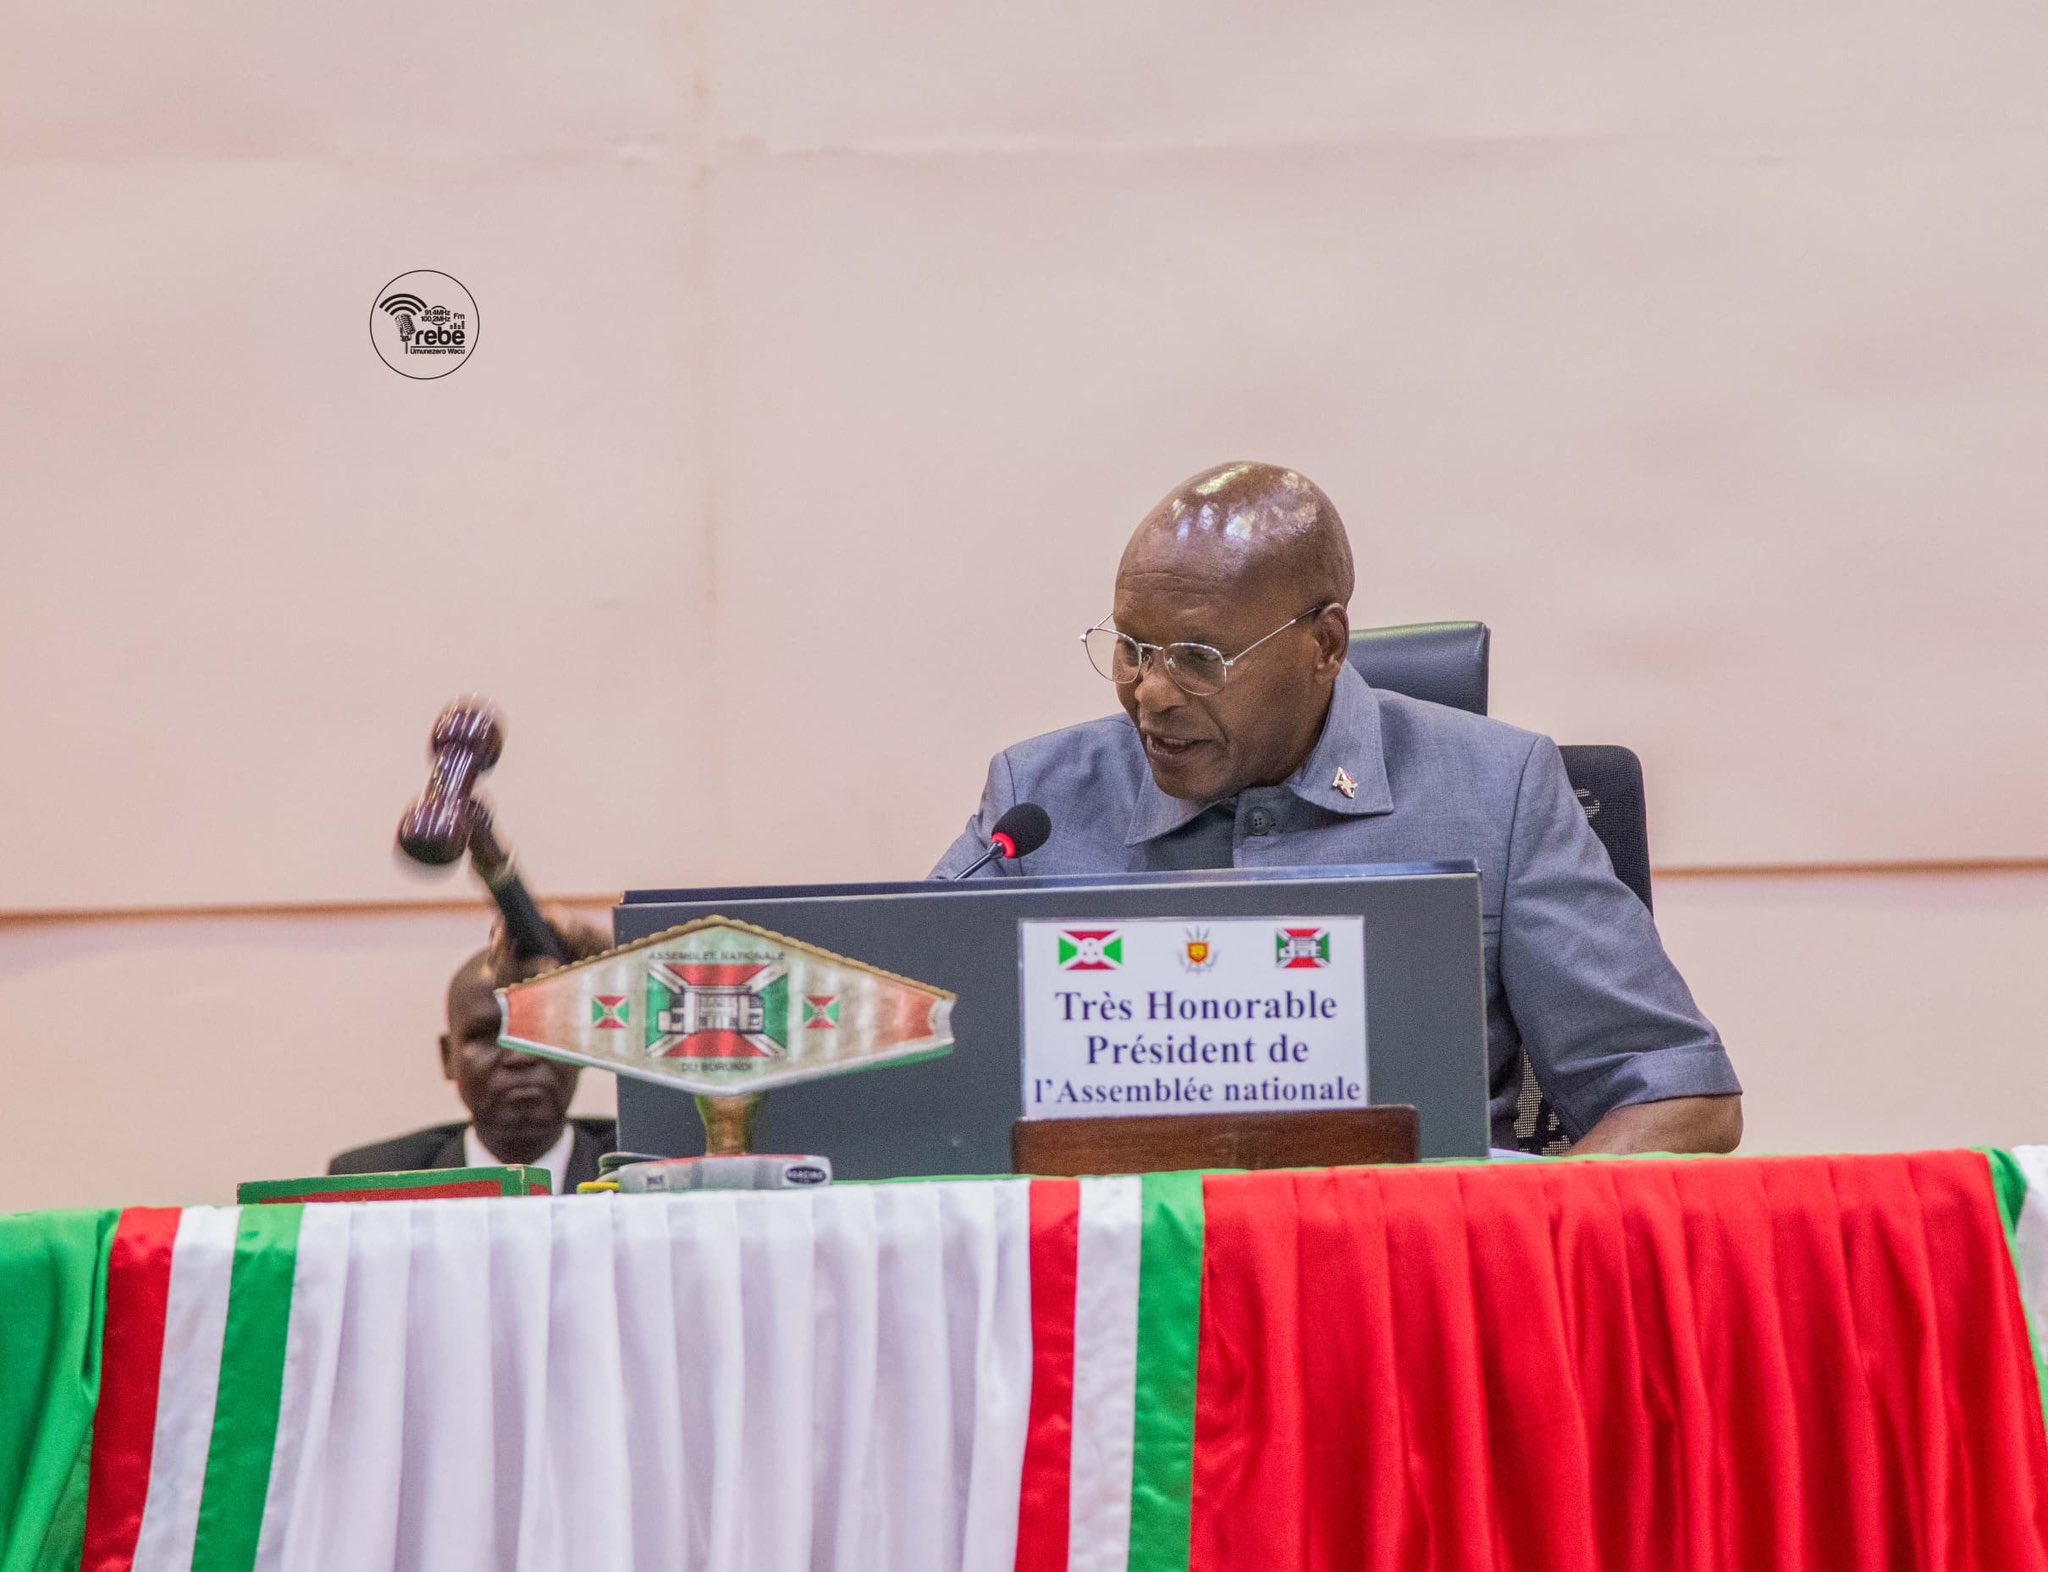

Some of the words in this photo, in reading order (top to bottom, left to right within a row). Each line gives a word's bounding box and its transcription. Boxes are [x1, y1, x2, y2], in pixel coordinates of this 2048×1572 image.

[1055, 990, 1133, 1021] Très
[1147, 988, 1338, 1021] Honorable
[1085, 1033, 1256, 1065] Président
[1268, 1033, 1309, 1063] de
[1223, 1075, 1361, 1101] nationale
